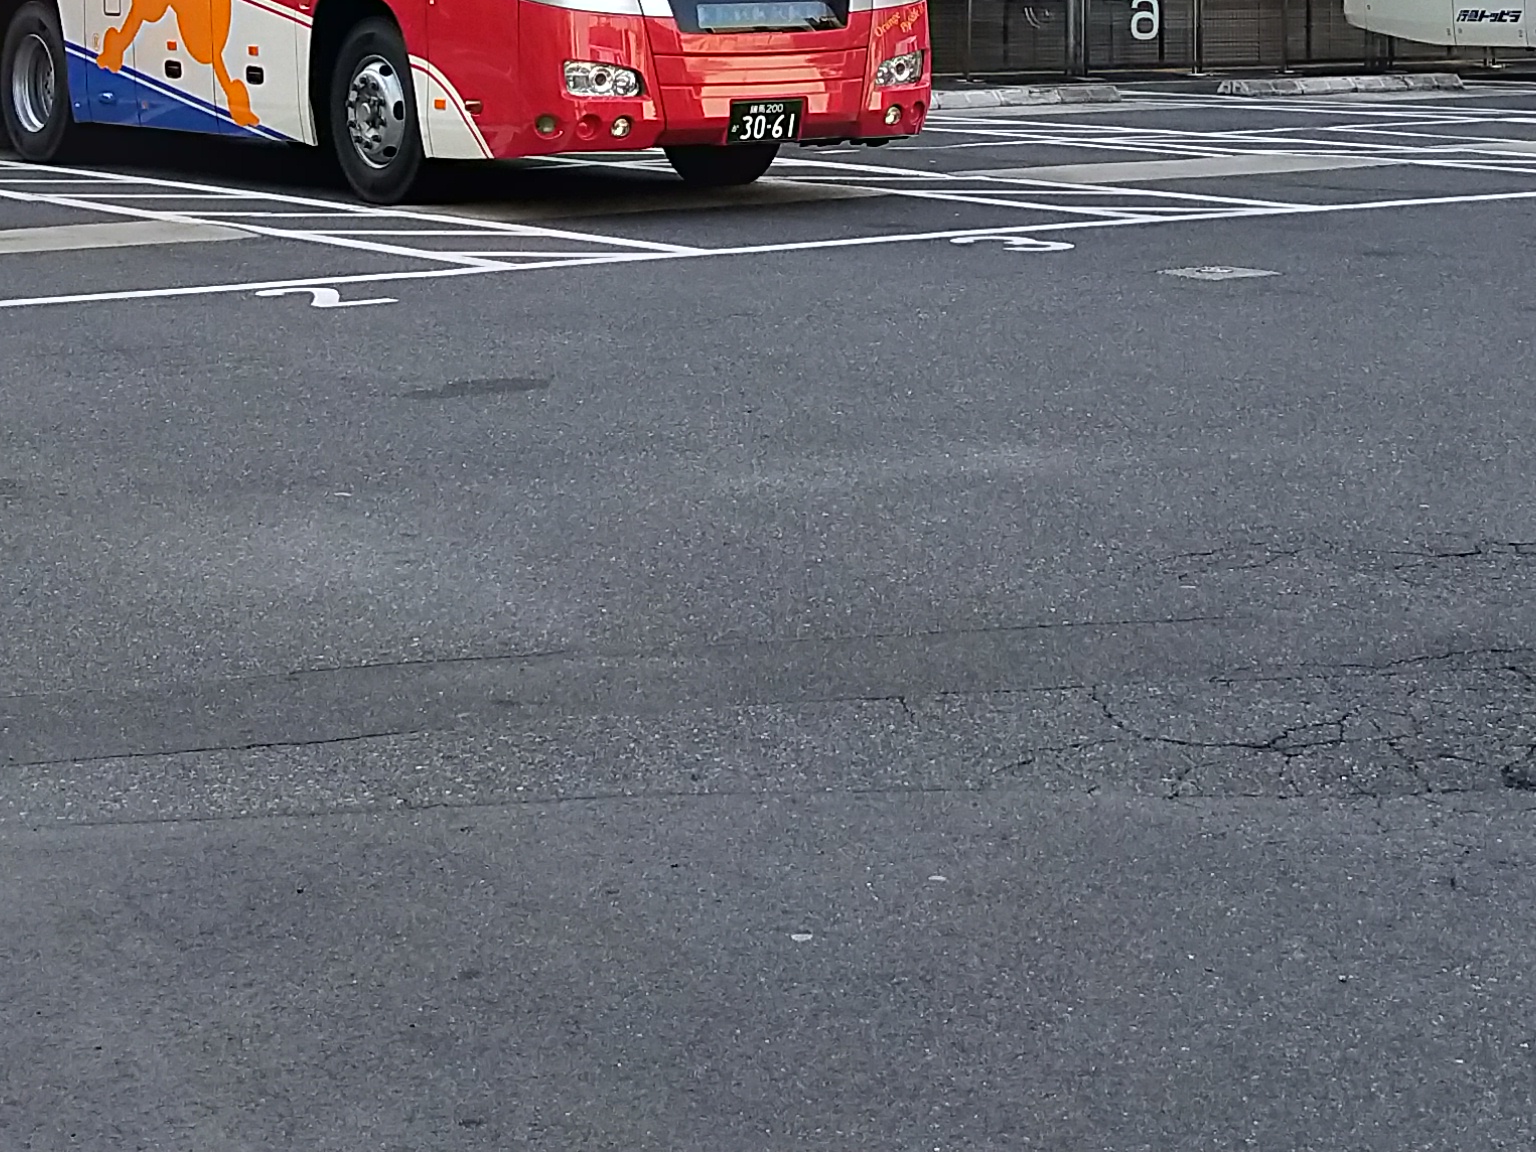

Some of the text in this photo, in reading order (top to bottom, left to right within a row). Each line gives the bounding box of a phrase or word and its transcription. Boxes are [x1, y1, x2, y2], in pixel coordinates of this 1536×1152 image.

[874, 11, 901, 37] Orange
[766, 103, 784, 114] 200
[739, 113, 795, 140] 30-61
[254, 286, 400, 308] 2
